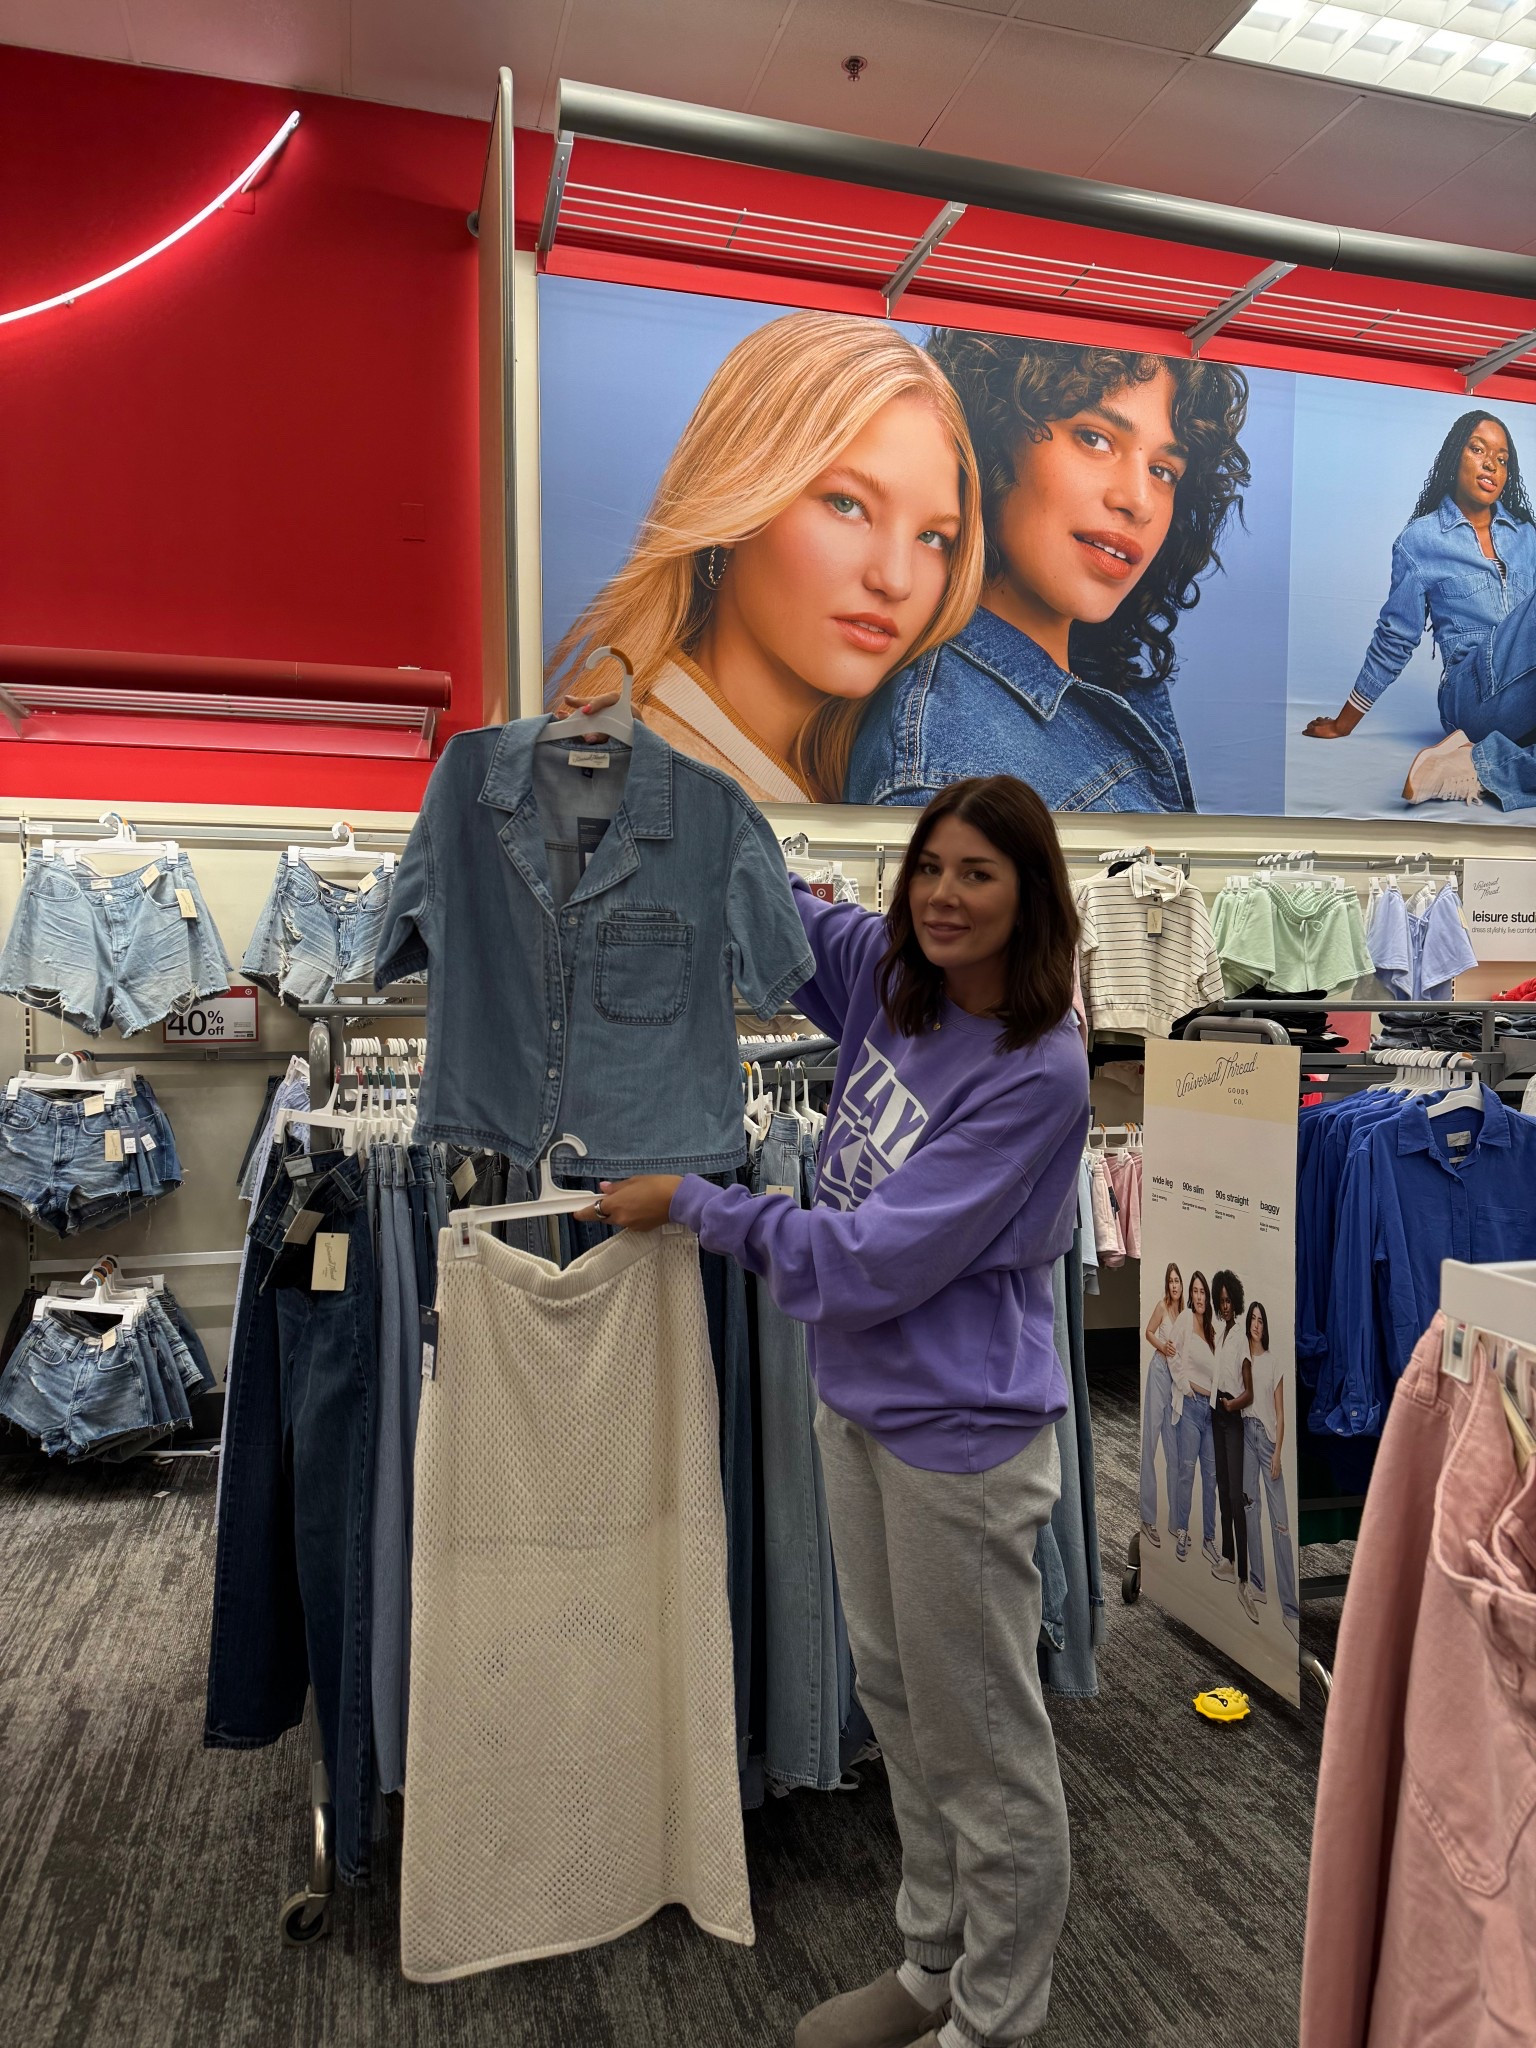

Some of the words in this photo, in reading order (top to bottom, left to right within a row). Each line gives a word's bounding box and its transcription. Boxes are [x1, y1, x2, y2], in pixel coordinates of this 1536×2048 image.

[1472, 910, 1508, 923] leisure
[208, 1026, 224, 1036] off
[1175, 1061, 1222, 1098] Universal
[1227, 1088, 1249, 1096] GOODS
[1152, 1175, 1165, 1186] wide
[1165, 1177, 1174, 1189] leg
[1182, 1181, 1193, 1193] 90s
[1193, 1185, 1205, 1196] slim
[1215, 1189, 1226, 1201] 90s
[1226, 1192, 1250, 1207] straight
[1260, 1200, 1280, 1216] baggy
